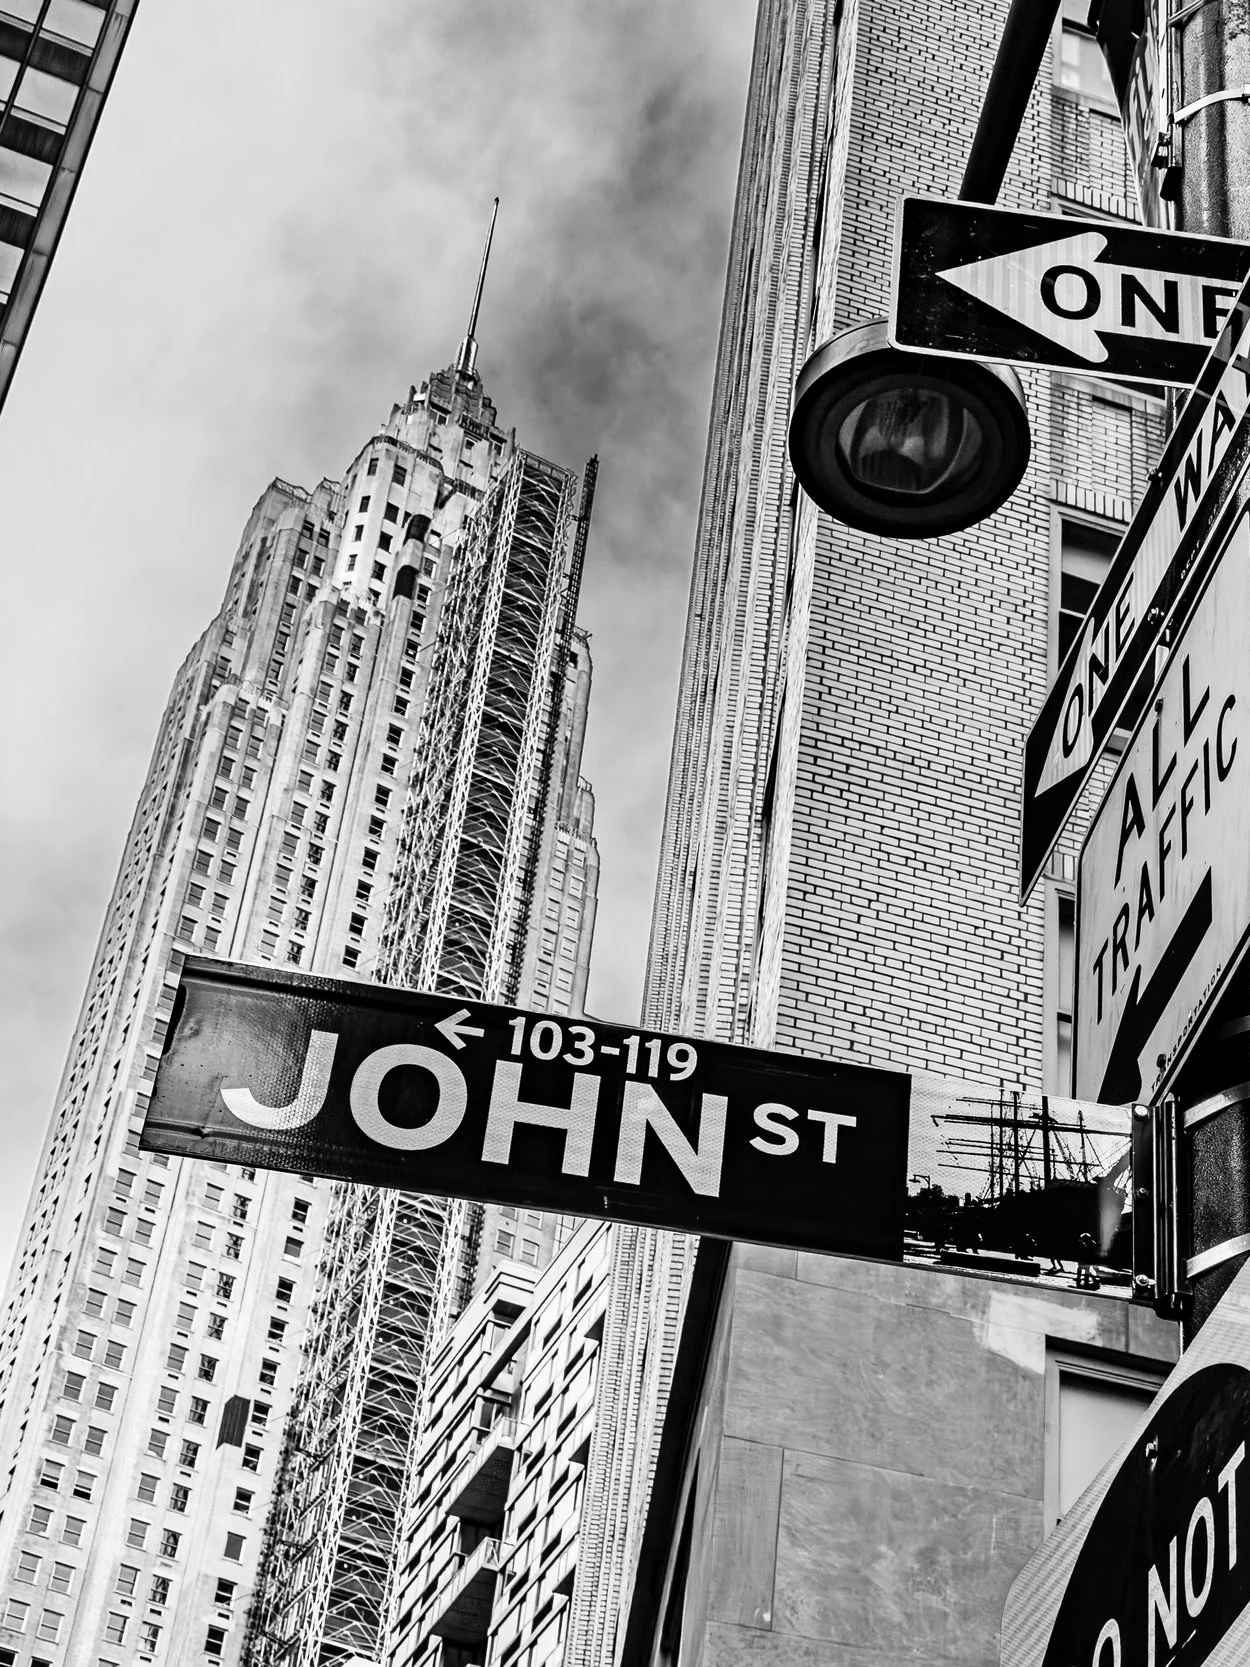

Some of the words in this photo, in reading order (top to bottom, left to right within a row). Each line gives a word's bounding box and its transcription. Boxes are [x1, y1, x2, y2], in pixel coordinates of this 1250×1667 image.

[1040, 264, 1240, 340] ONE
[1180, 539, 1201, 581] DEPT
[1062, 570, 1136, 760] ONE
[1113, 653, 1211, 892] ALL
[1092, 693, 1238, 1026] TRAFFIC
[507, 1016, 698, 1082] 103-119
[1151, 963, 1222, 1094] TRNSPORTATION
[219, 1029, 729, 1199] JOHN
[748, 1102, 857, 1164] ST
[1147, 1439, 1247, 1667] NOT
